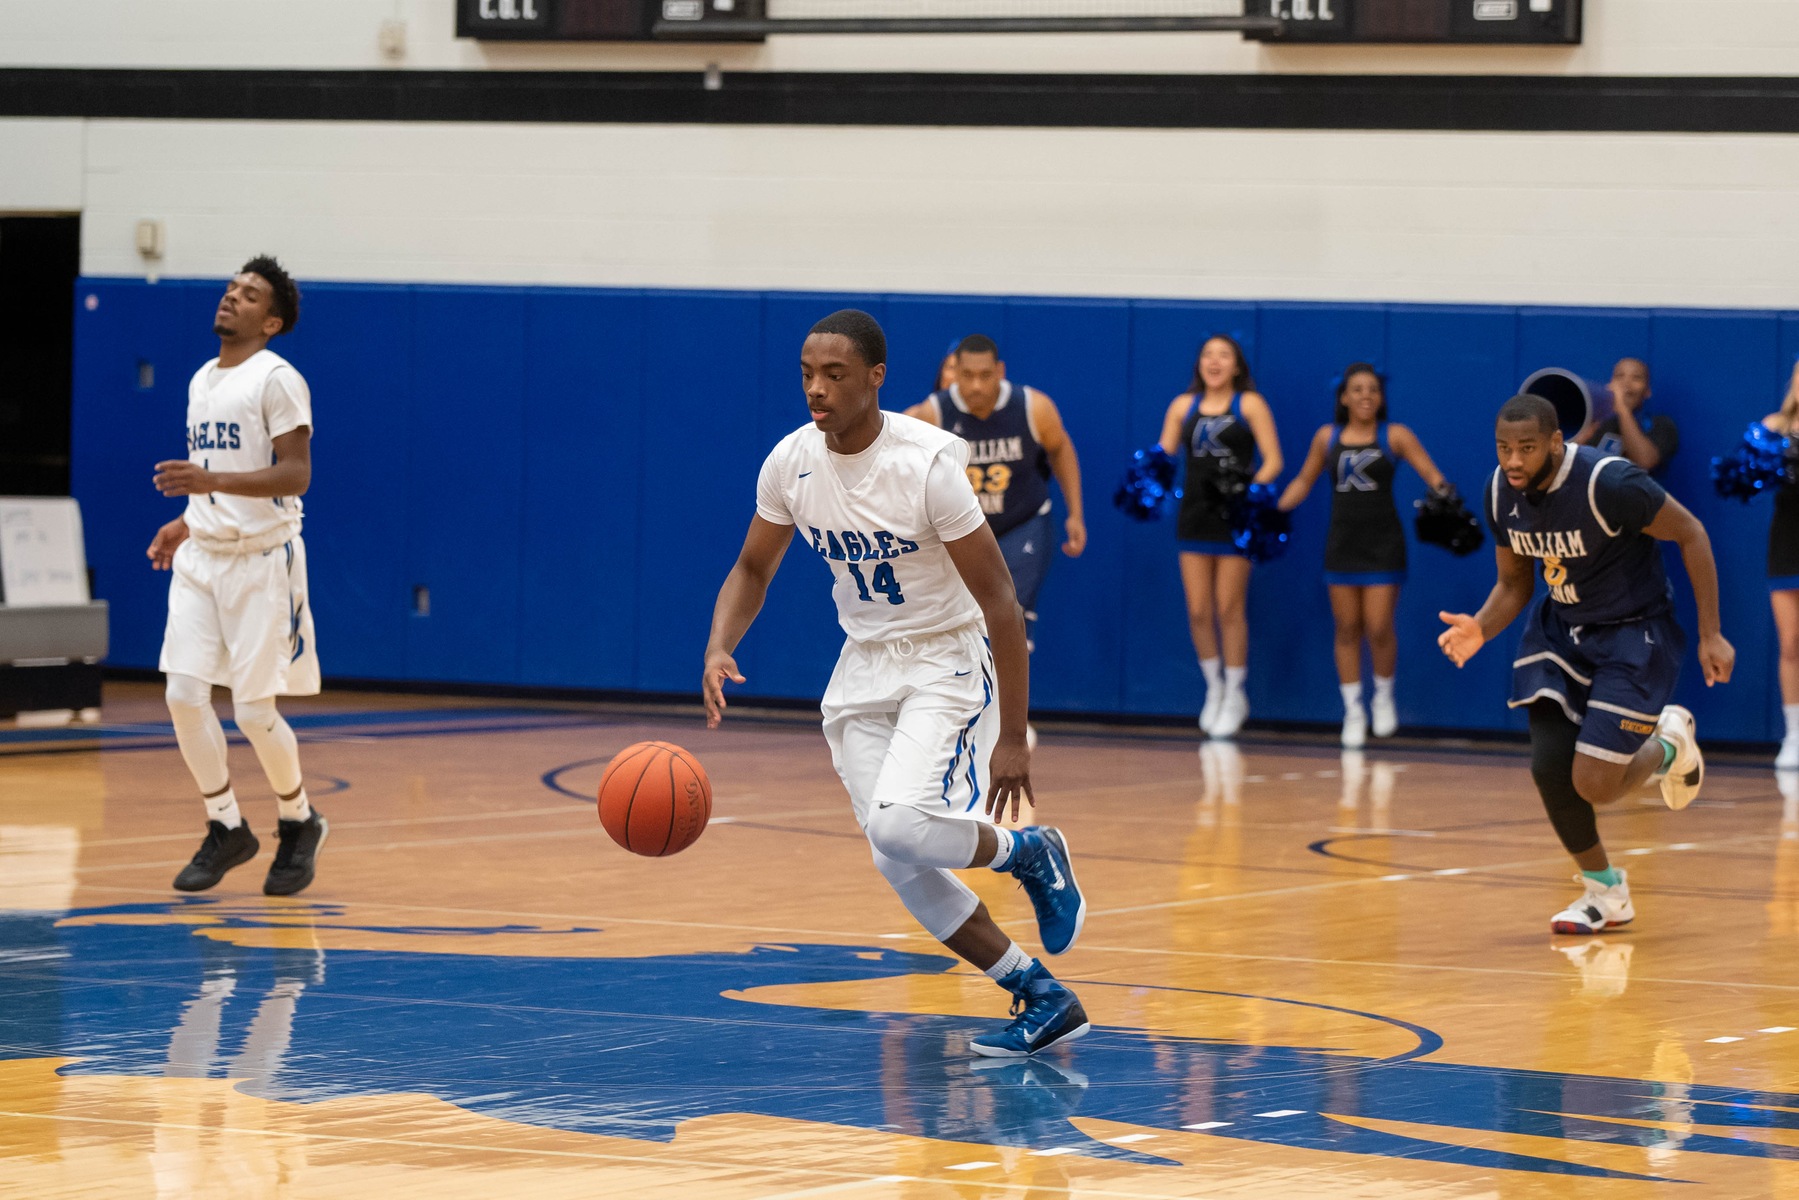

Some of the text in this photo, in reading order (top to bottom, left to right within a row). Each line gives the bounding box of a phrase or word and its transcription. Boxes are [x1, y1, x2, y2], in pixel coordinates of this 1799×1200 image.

[187, 422, 241, 451] GLES
[1336, 449, 1382, 492] K
[808, 526, 919, 562] EAGLES
[1507, 528, 1588, 559] WILLIAM
[847, 561, 905, 605] 14
